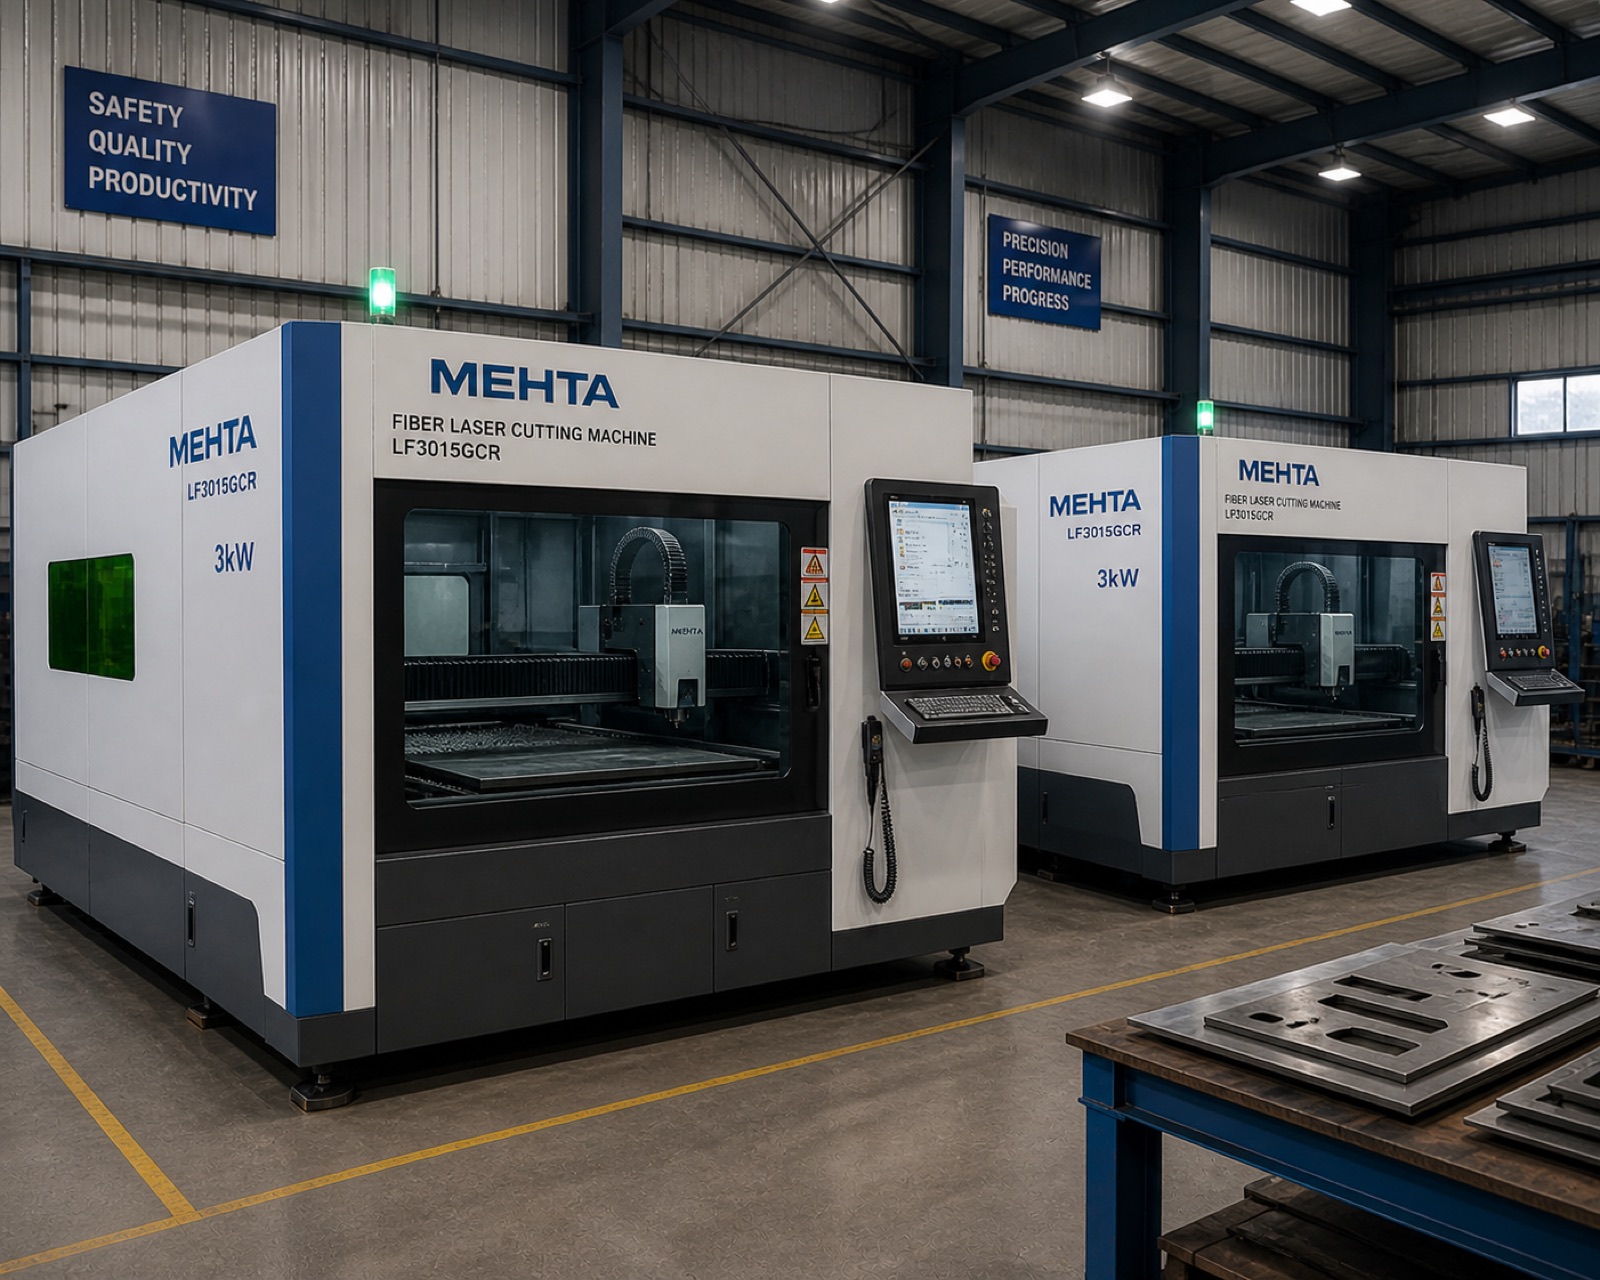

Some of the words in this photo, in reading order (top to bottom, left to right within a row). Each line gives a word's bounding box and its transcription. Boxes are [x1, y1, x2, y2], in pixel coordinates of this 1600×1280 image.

[88, 91, 184, 128] SAFETY
[88, 129, 192, 165] QUALITY
[88, 165, 258, 211] PRODUCTIVITY
[1003, 231, 1068, 260] PRECISION
[1003, 258, 1092, 290] PERFORMANCE
[1003, 284, 1069, 311] PROGRESS
[431, 358, 620, 409] MEHTA
[169, 415, 258, 469] MEHTA
[392, 414, 445, 433] FIBER
[450, 418, 506, 438] LASER
[511, 422, 583, 442] CUTTING
[588, 427, 657, 447] MACHINE
[392, 438, 501, 462] LF3015GCR
[187, 471, 257, 501] LF3015GCR
[1239, 459, 1320, 487] MEHTA
[1049, 488, 1142, 518] MEHTA
[1225, 493, 1248, 505] FIBER
[1250, 495, 1275, 506] LASER
[1276, 497, 1308, 509] CUTTING
[1309, 499, 1342, 511] MACHINE
[1067, 523, 1142, 540] LF3015GCR
[214, 541, 255, 574] 3kW
[1097, 568, 1140, 588] 3kW
